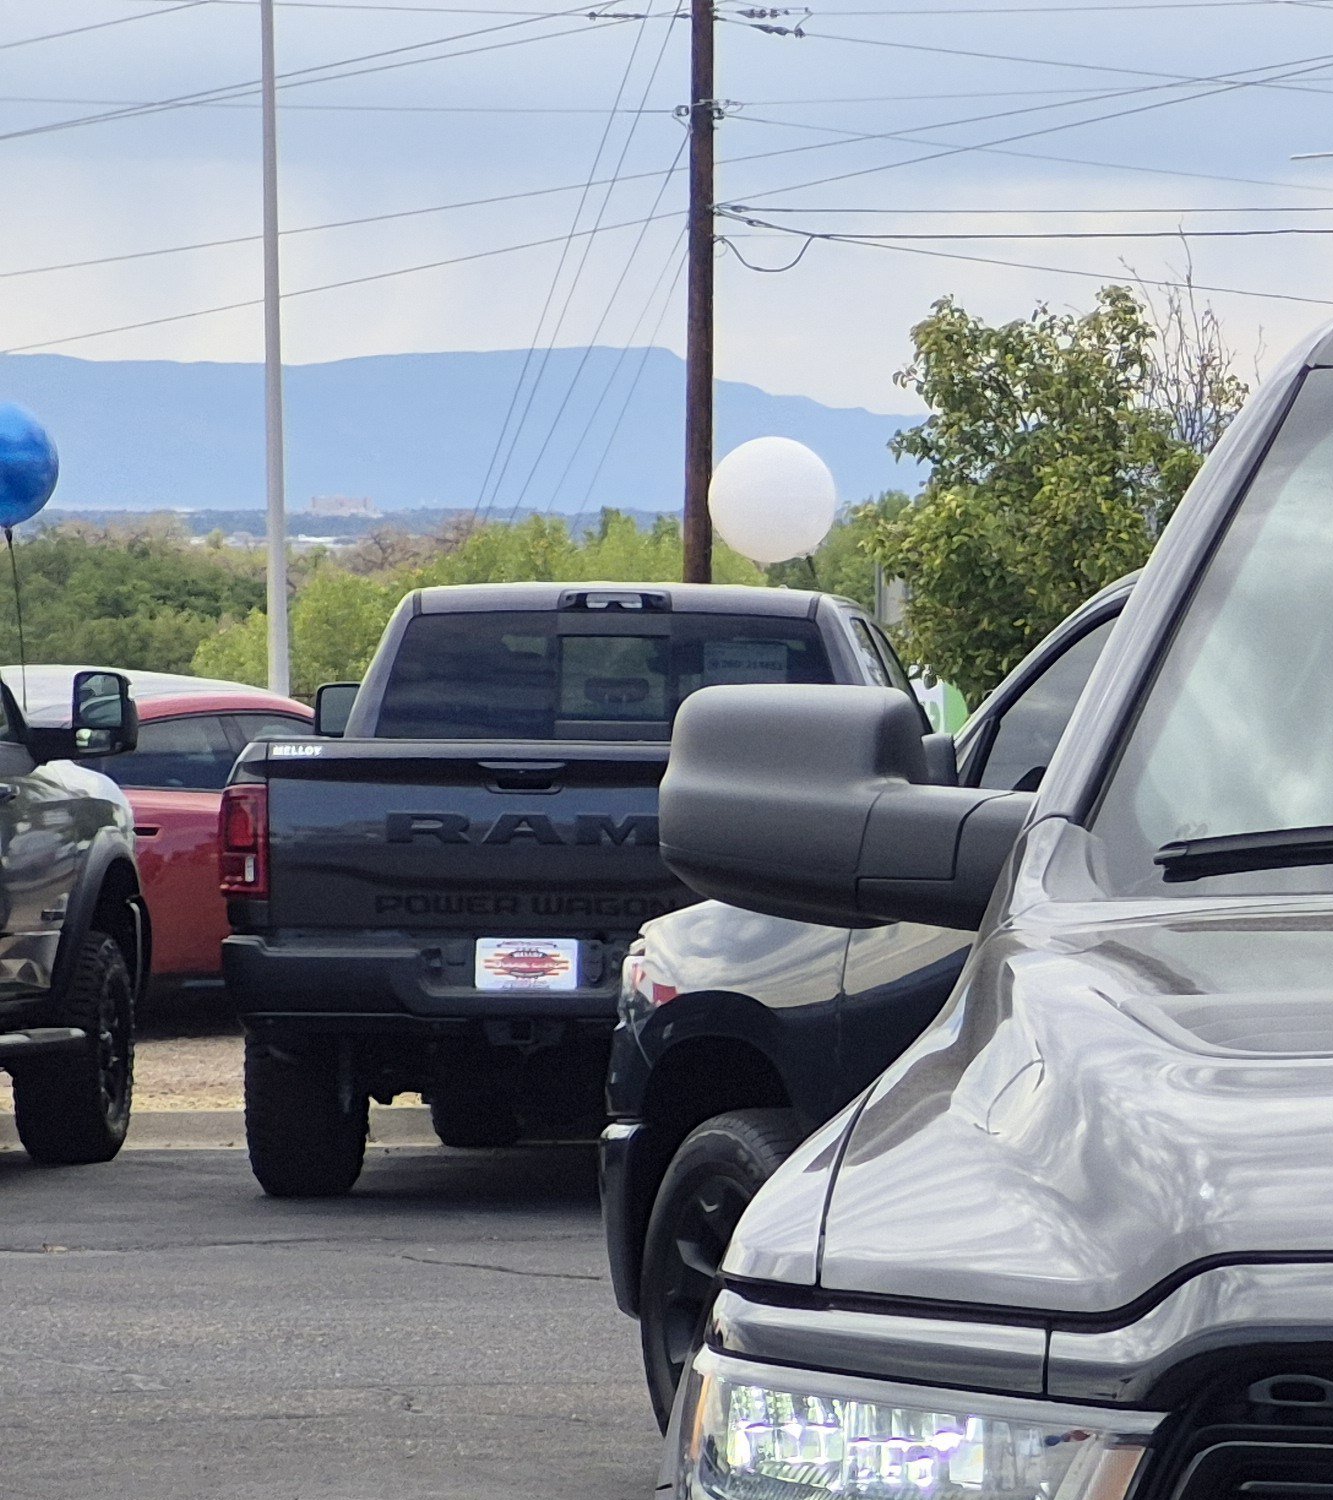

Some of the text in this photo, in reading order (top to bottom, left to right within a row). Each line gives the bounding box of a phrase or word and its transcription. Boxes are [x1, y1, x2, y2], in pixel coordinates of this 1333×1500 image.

[273, 745, 322, 756] MELLOY
[386, 812, 661, 845] RAM
[376, 895, 519, 915] POWER
